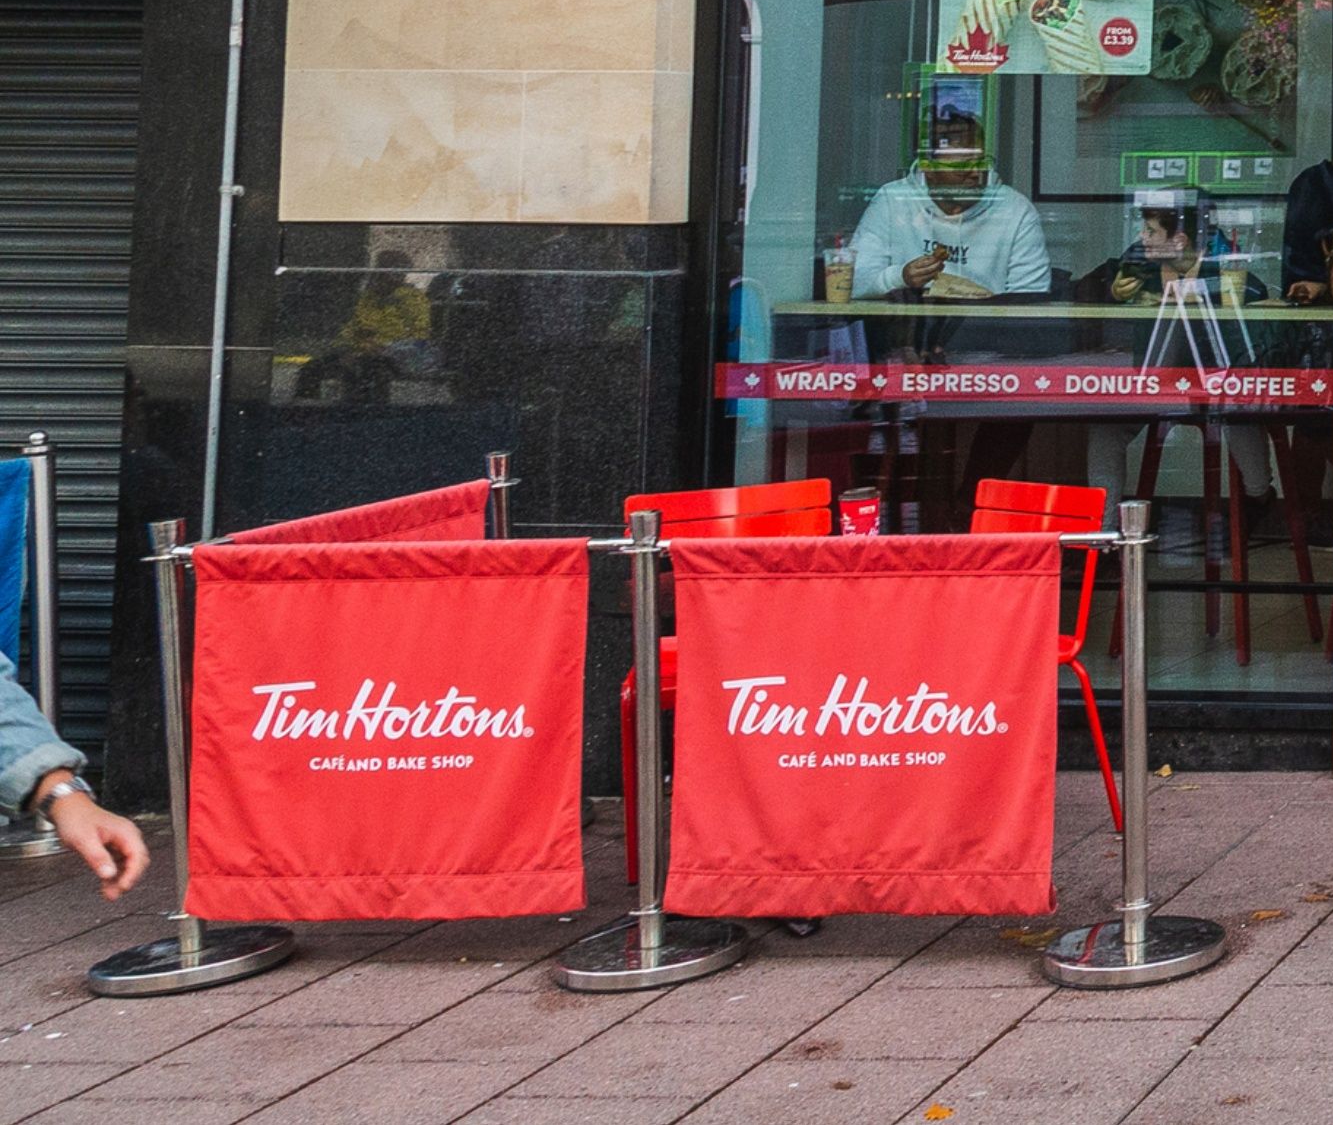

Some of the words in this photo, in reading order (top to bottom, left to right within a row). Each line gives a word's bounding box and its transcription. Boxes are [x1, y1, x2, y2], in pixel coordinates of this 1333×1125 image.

[1106, 27, 1132, 35] FROM
[776, 371, 857, 391] WRAPS
[902, 373, 1020, 394] ESPRESSO
[1065, 376, 1161, 395] DONUTS
[1206, 376, 1296, 397] COFFEE
[252, 681, 339, 741] Tim
[721, 676, 808, 735] Tim
[309, 754, 344, 771] CAFÉ
[347, 757, 382, 772] AND
[387, 756, 427, 770] BAKE
[432, 754, 474, 769] SHOP
[778, 751, 817, 768] CAFÉ
[821, 754, 856, 767] AND
[860, 753, 901, 767] BAKE
[905, 751, 946, 766] SHOP
